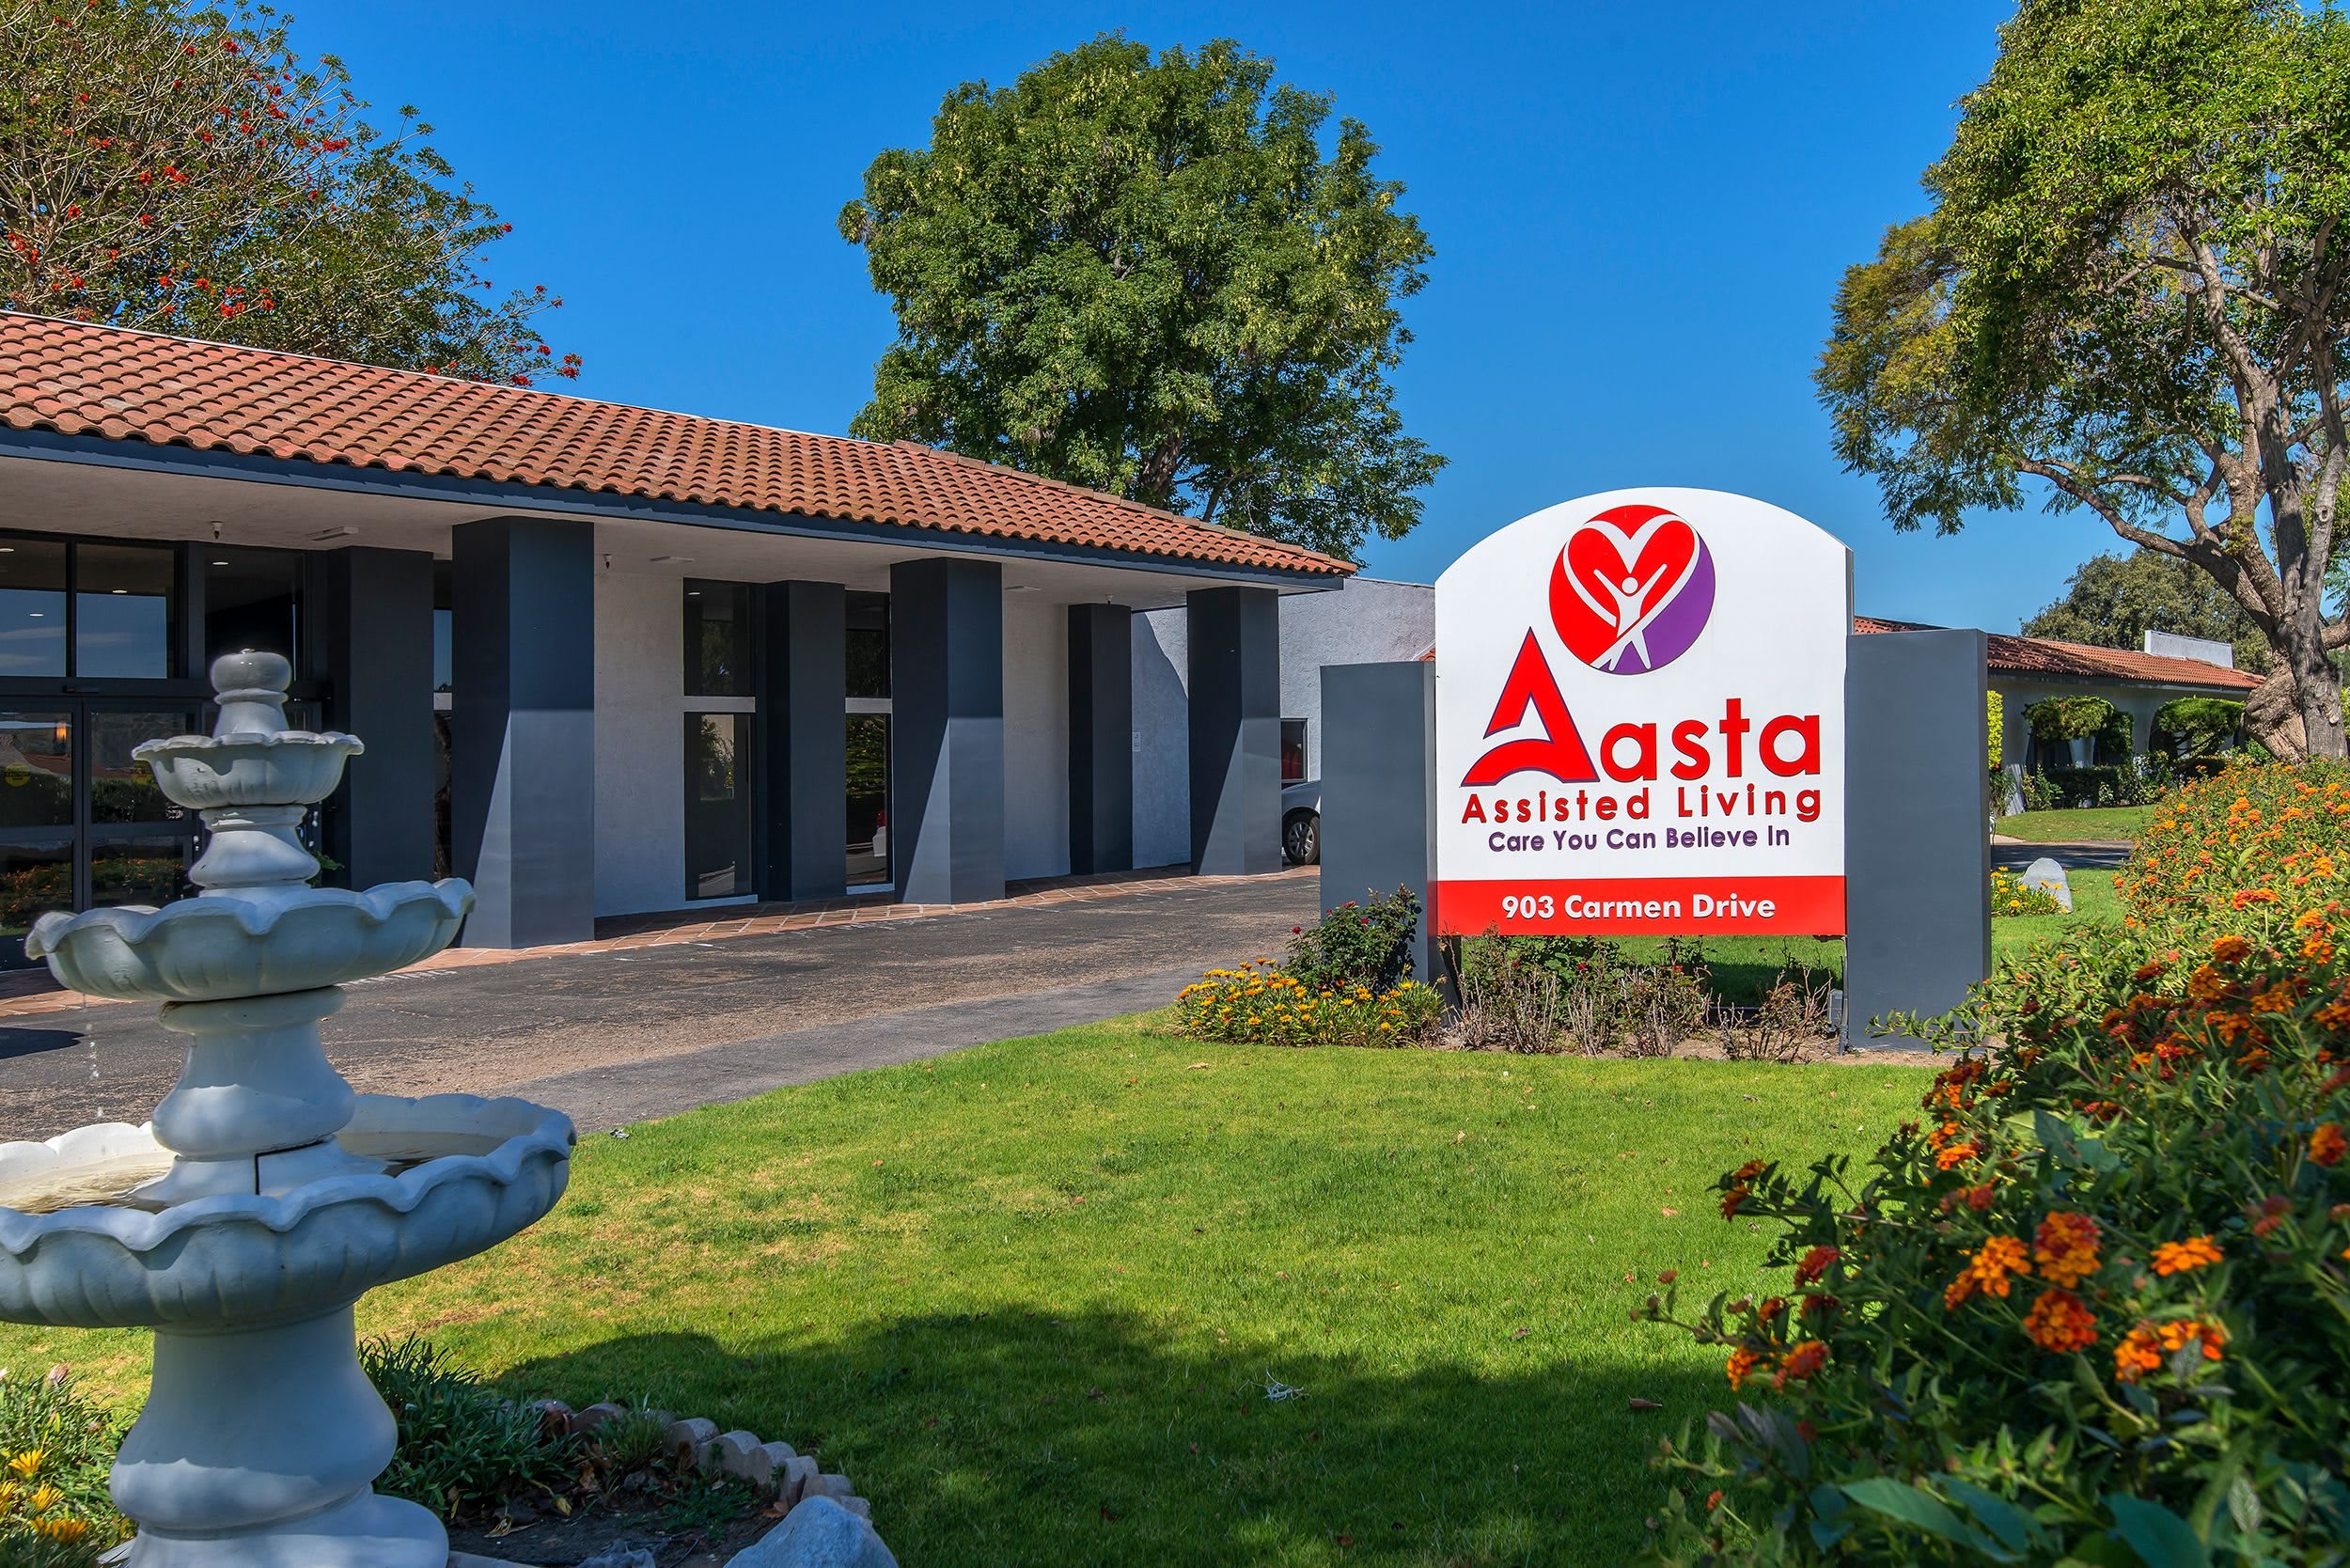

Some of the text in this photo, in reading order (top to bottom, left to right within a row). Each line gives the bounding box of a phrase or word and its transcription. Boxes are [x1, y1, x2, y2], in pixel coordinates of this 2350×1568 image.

[1460, 625, 1821, 788] Aasta
[1461, 782, 1821, 823] Assisted Living
[1488, 825, 1790, 852] Care You Can Believe In
[1502, 892, 1776, 919] 903 Carmen Drive
